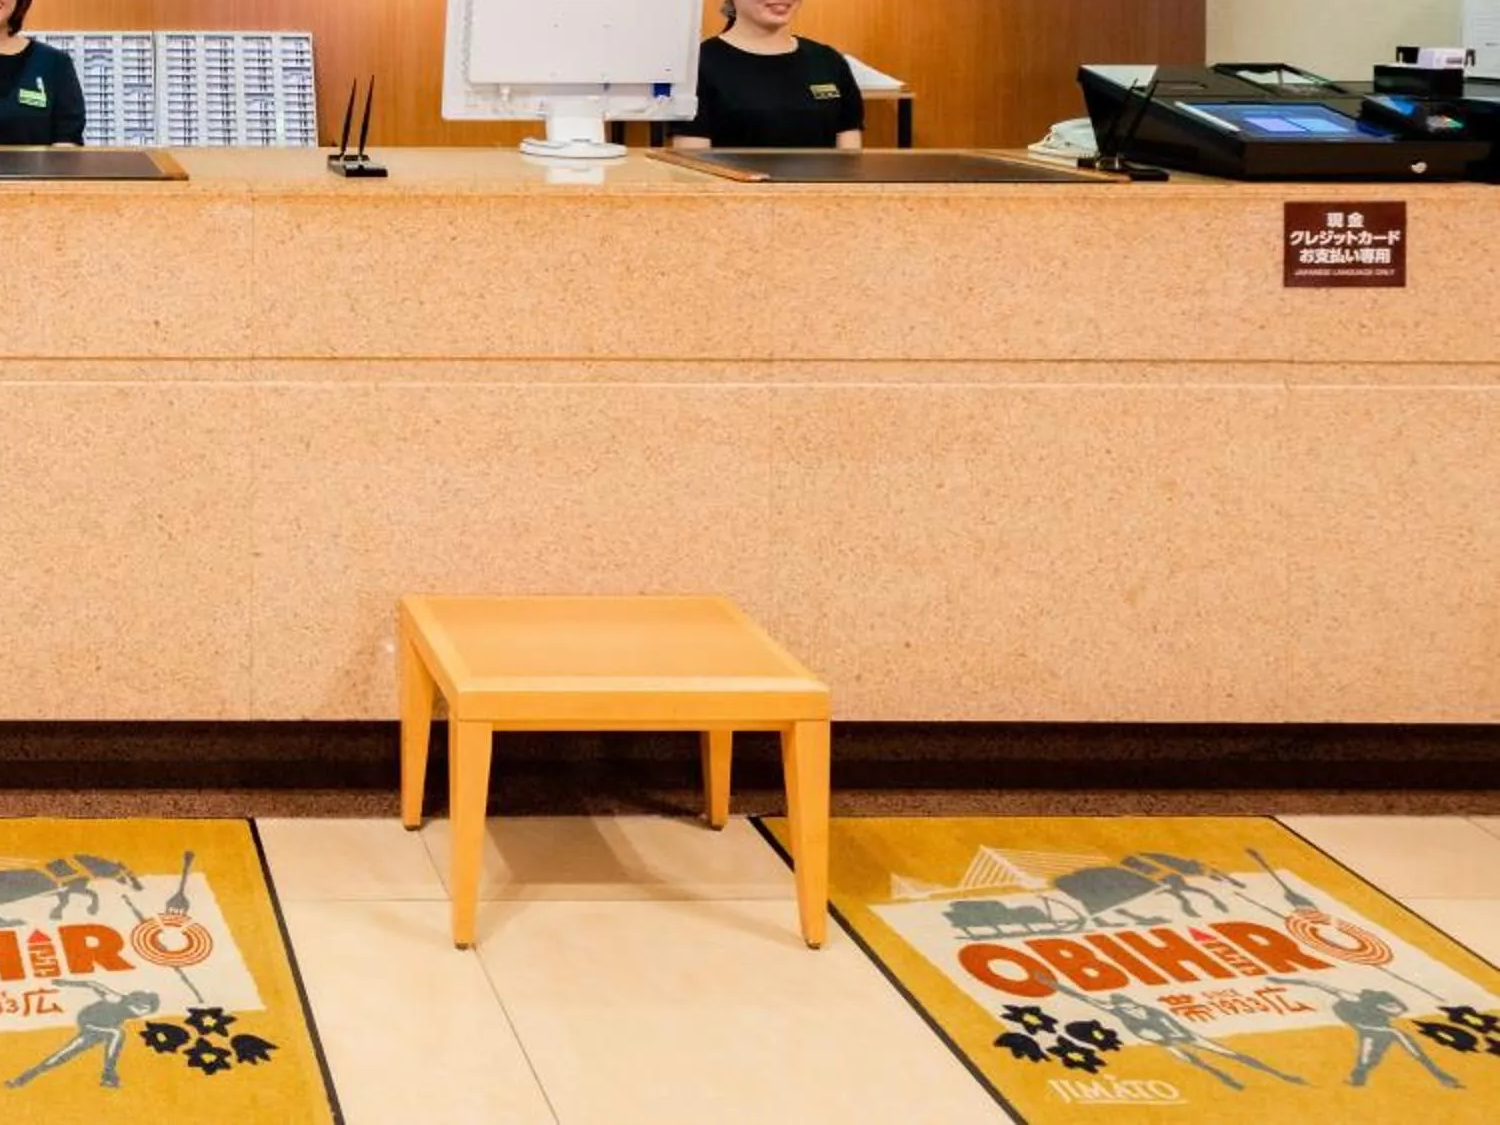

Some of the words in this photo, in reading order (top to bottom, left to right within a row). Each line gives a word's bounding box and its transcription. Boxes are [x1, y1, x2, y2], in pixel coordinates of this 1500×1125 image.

[1289, 229, 1402, 246] クレジットカード
[1299, 247, 1392, 264] お支払い専用
[957, 907, 1395, 998] OBIHIRO
